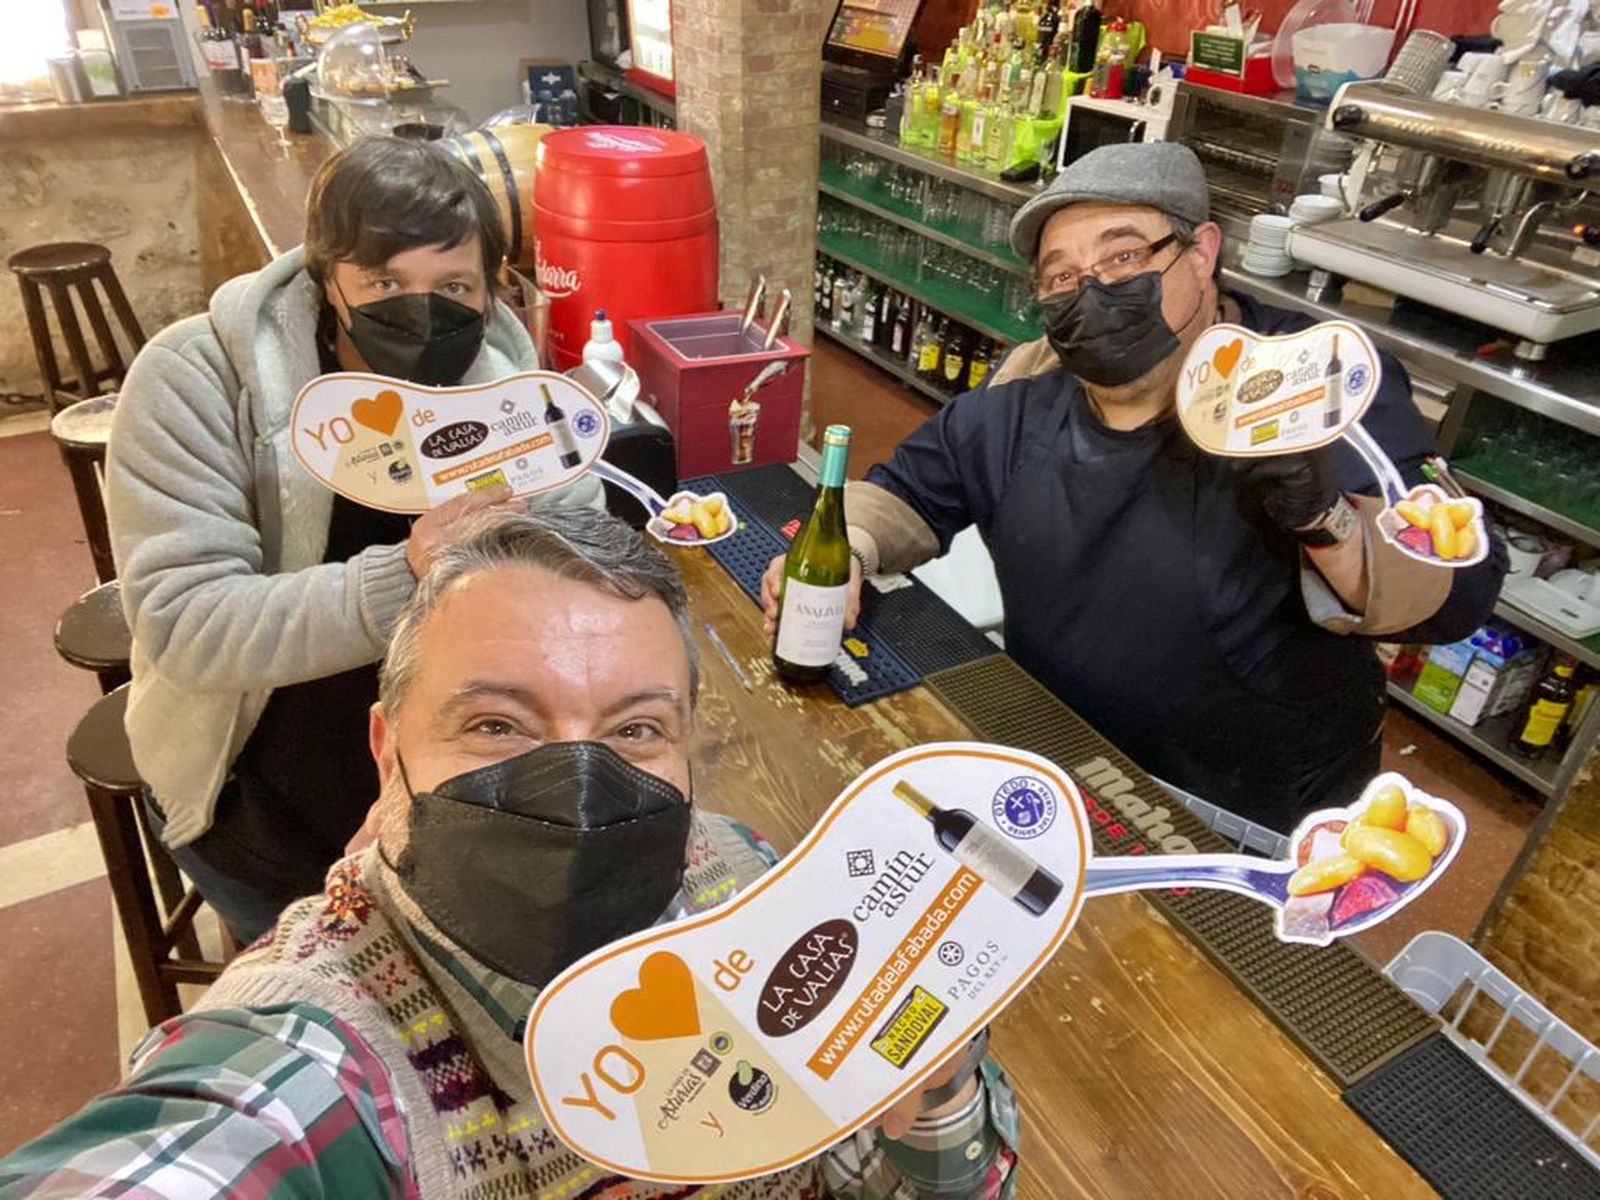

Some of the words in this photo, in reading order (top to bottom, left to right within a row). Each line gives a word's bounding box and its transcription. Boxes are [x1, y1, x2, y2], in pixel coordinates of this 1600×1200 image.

[1187, 361, 1210, 389] YO
[303, 417, 354, 450] YO
[412, 409, 436, 427] de
[428, 435, 447, 447] LA
[1075, 757, 1198, 854] Maho
[880, 852, 936, 918] astur
[763, 986, 794, 1012] LA
[789, 934, 834, 978] CASA
[819, 873, 976, 1066] www.rutadelafabada.com
[948, 940, 999, 1000] PAGOS
[562, 1044, 646, 1121] YO
[713, 949, 755, 992] de
[781, 1007, 803, 1029] DE
[887, 1002, 941, 1061] SANDOVAL
[701, 1111, 724, 1137] y
